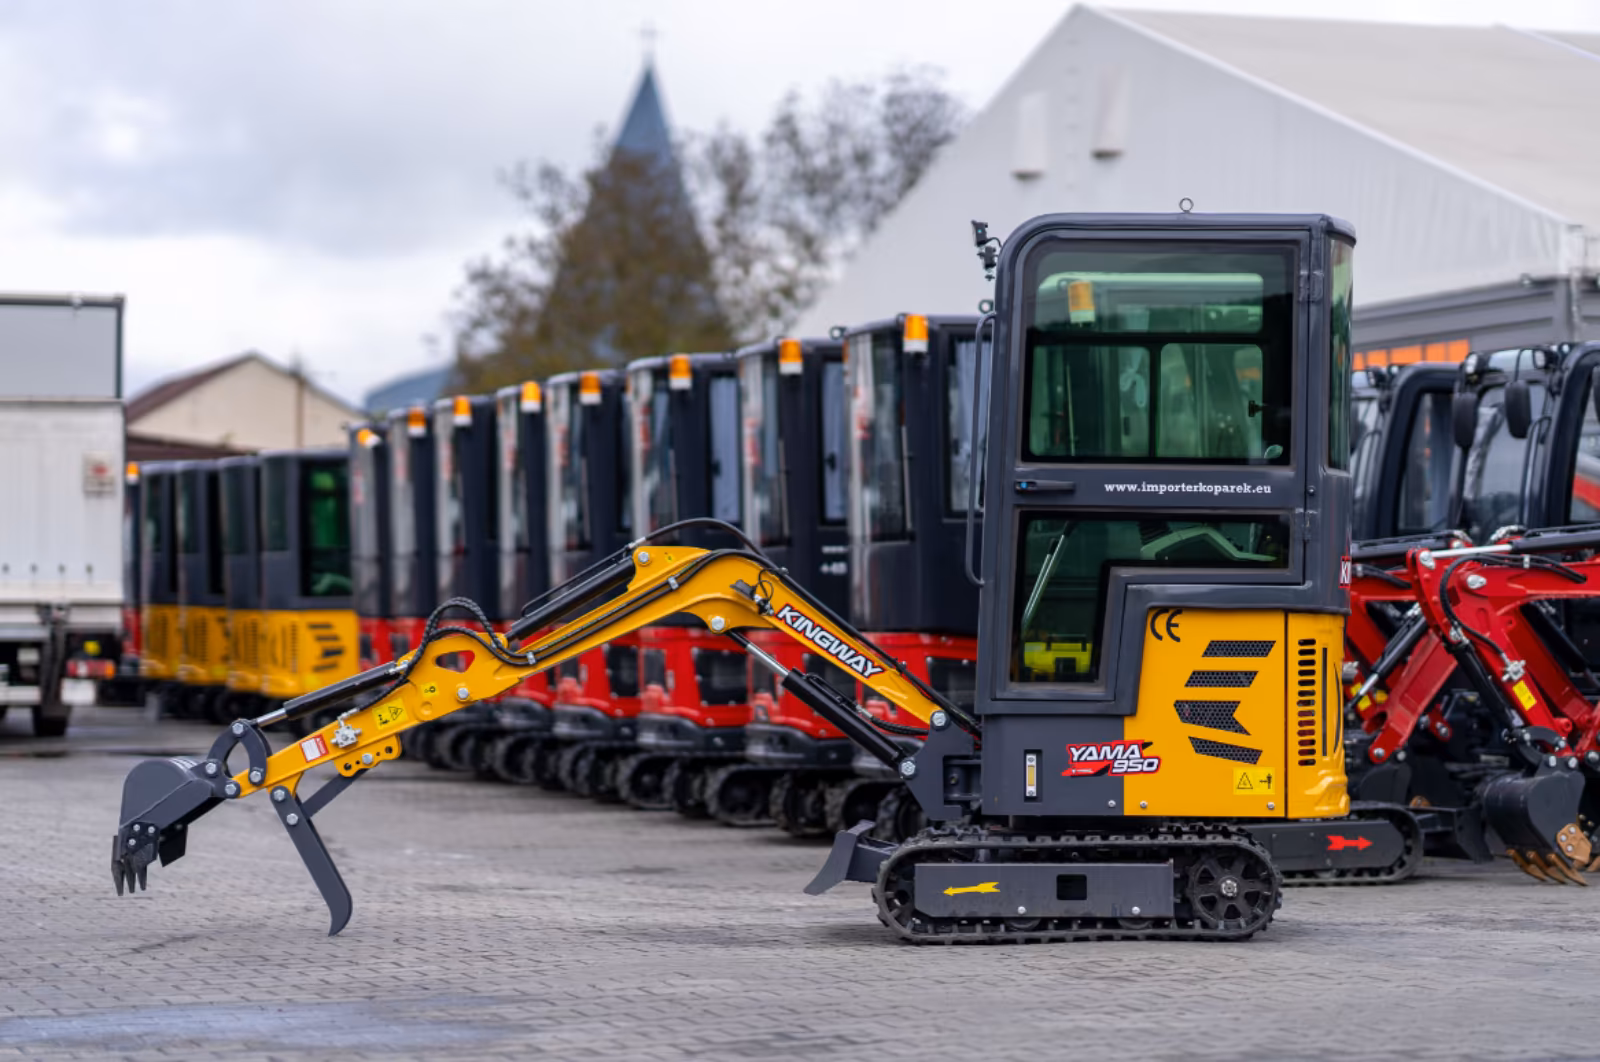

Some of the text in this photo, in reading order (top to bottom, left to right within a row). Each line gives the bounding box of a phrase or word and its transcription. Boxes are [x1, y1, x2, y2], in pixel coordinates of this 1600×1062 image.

[1104, 481, 1272, 496] www.importerkoparek.eu
[1150, 608, 1183, 642] CE
[777, 605, 883, 677] KINGWAY
[1069, 744, 1141, 761] YAMA
[1111, 758, 1159, 773] 950
